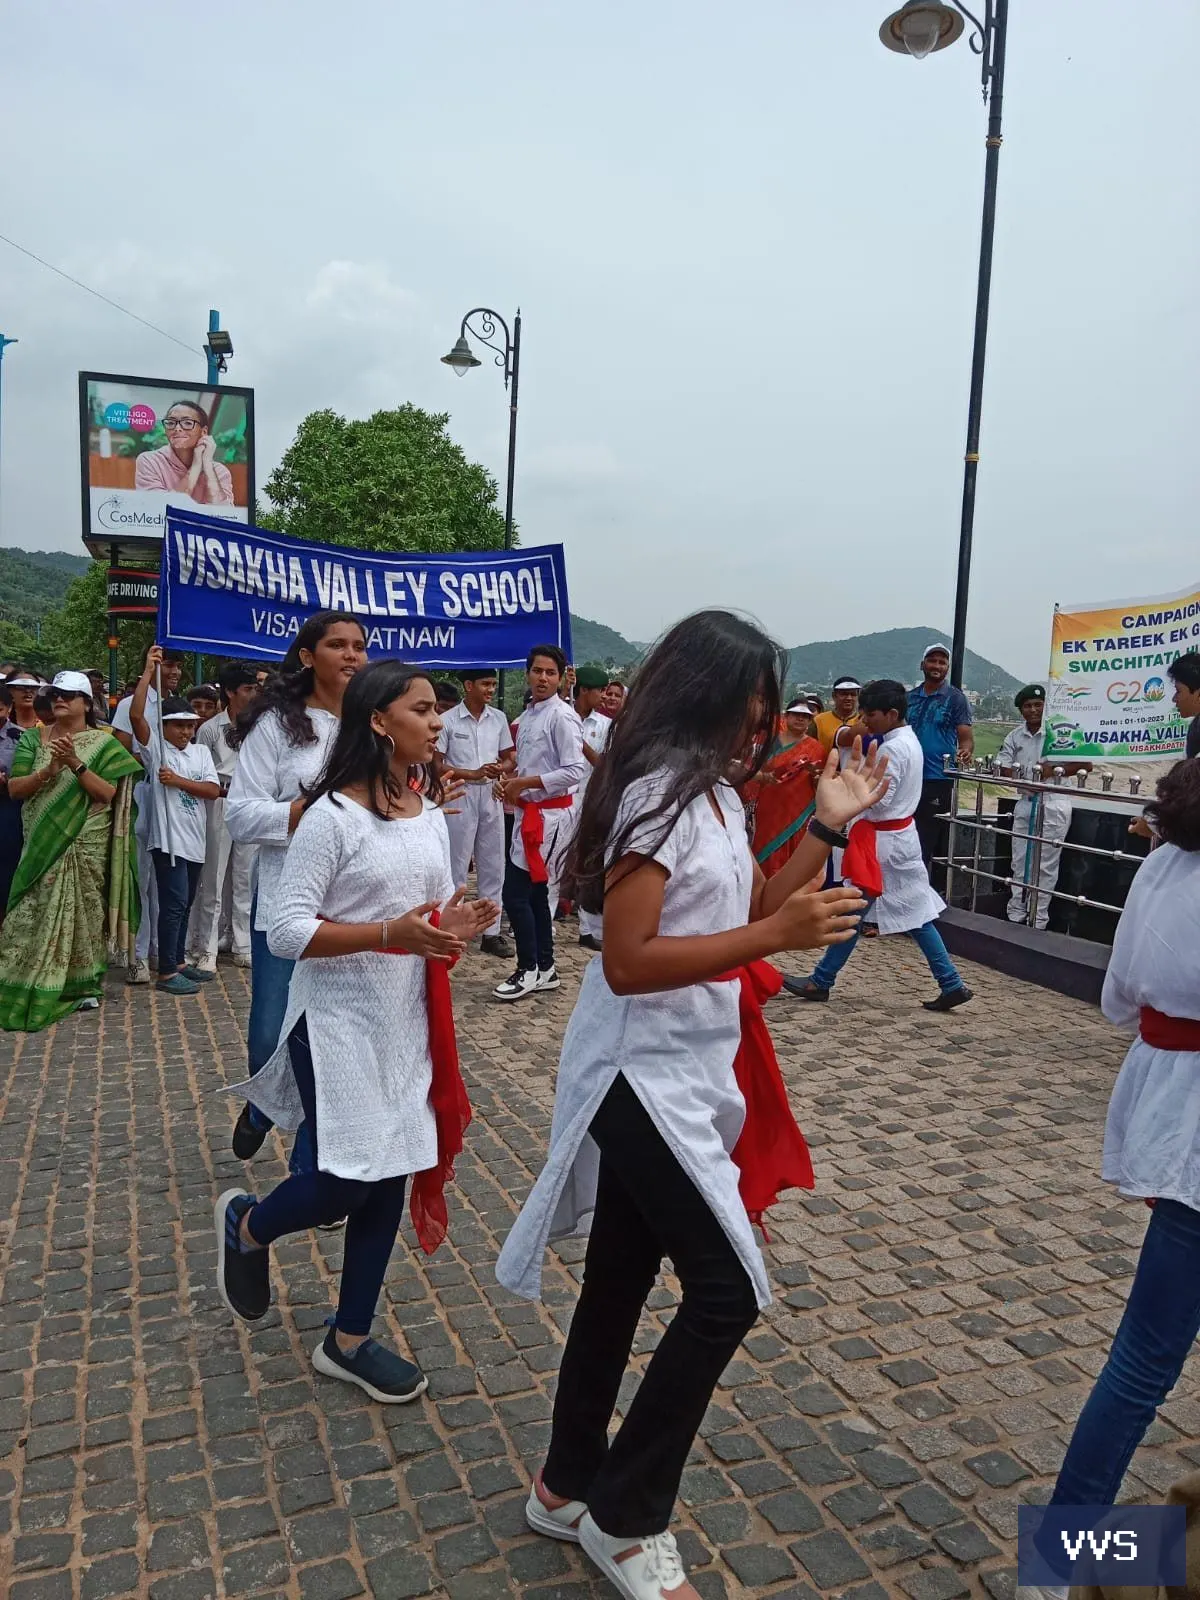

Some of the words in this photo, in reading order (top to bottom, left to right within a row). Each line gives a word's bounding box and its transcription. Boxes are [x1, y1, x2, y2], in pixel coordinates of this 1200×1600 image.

[106, 416, 154, 426] TREATMENT
[113, 409, 147, 418] VITILIGO
[174, 530, 309, 606] VISAKHA
[310, 558, 428, 617] VALLEY
[439, 566, 554, 618] SCHOOL
[120, 583, 158, 598] DRIVING
[251, 608, 455, 651] VISAATNAM
[1062, 640, 1087, 653] EK
[1093, 632, 1165, 652] TAREEK
[1170, 627, 1188, 643] EK
[1068, 649, 1180, 673] SWACHITATA
[1124, 715, 1165, 725] 01-10-2023
[1084, 729, 1151, 743] VISAKHA
[1155, 725, 1187, 740] VALL
[1129, 741, 1185, 752] VISAKHAPATN
